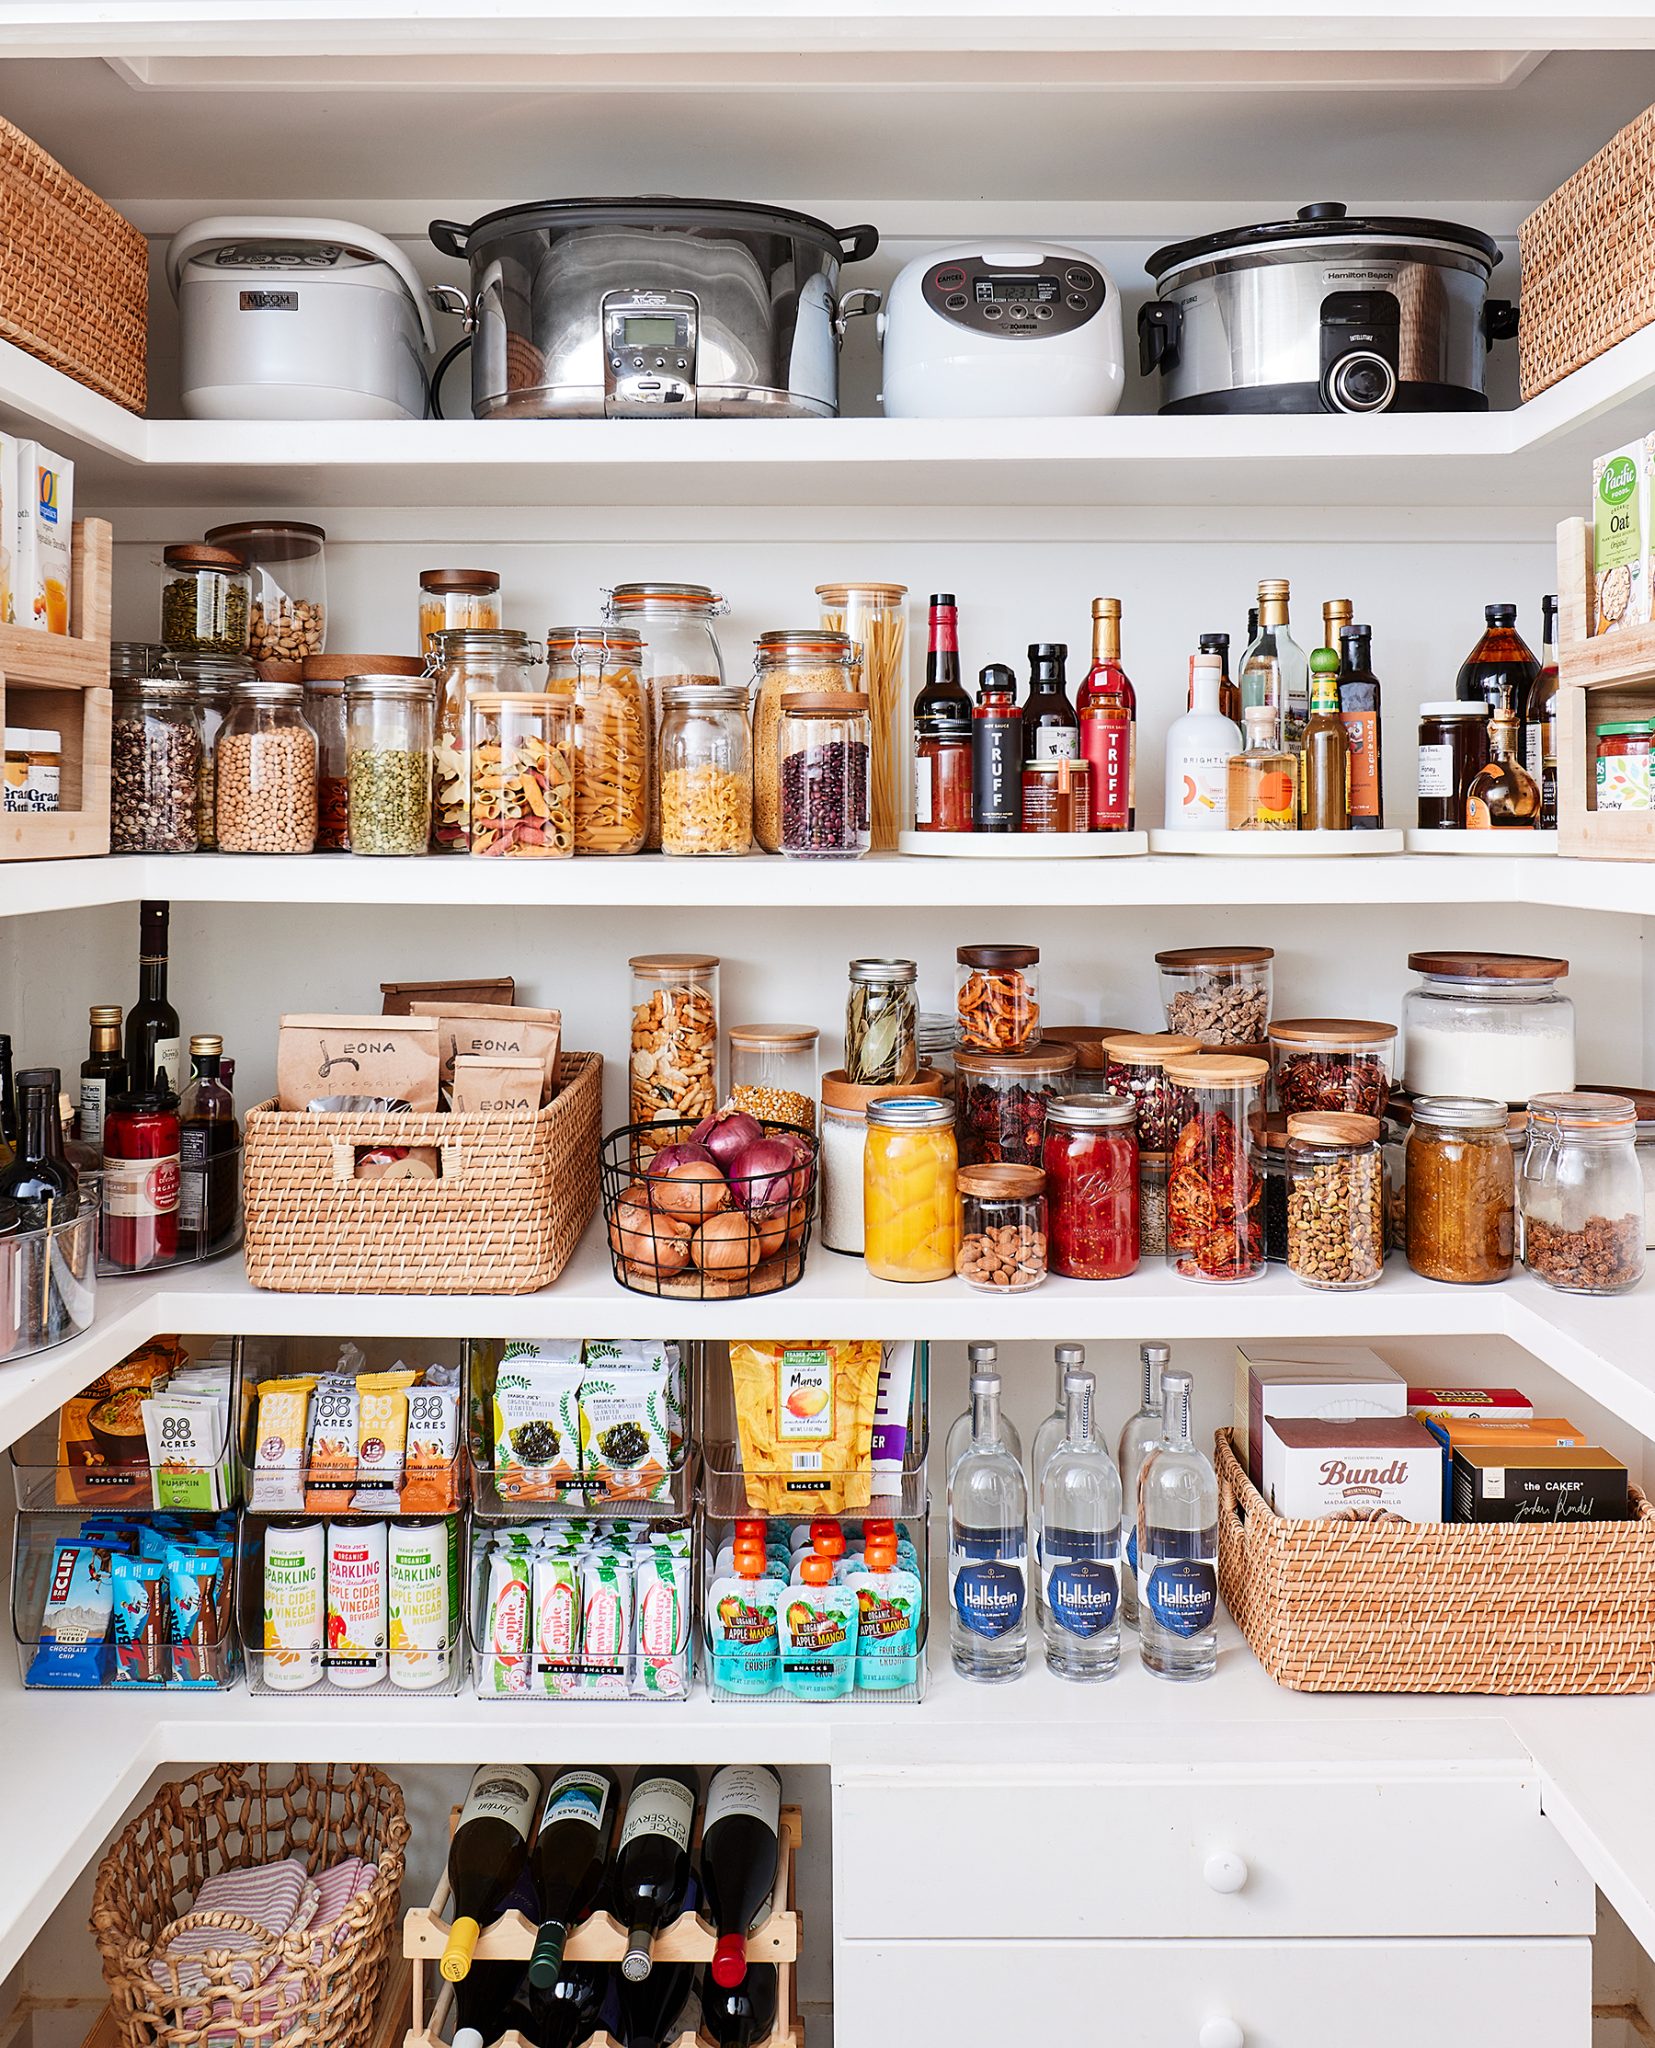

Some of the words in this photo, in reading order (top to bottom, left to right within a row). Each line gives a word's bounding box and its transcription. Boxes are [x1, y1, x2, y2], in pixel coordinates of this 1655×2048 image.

[1328, 269, 1367, 279] Hamilton
[1367, 271, 1394, 279] Beach
[247, 294, 291, 305] MICOM
[1604, 463, 1634, 494] Pacific
[18, 509, 30, 518] oth
[1610, 512, 1630, 533] Oat
[991, 732, 1003, 807] TRUFF
[1108, 733, 1119, 807] TRUFF
[790, 1372, 823, 1388] Mango
[320, 1395, 351, 1418] 88
[362, 1394, 392, 1420] 88
[412, 1395, 443, 1420] 88
[162, 1417, 192, 1440] 88
[315, 1419, 353, 1428] ACRES
[409, 1421, 446, 1430] ACRES
[160, 1440, 197, 1449] ACRES
[310, 1461, 350, 1469] CINNAMON
[1318, 1460, 1409, 1486] Bundt
[161, 1480, 199, 1488] PUMPKIN
[1524, 1482, 1540, 1491] the
[1545, 1482, 1581, 1491] CAKER
[55, 1551, 75, 1590] CLIF
[289, 1589, 316, 1605] CIDER
[353, 1583, 380, 1599] CIDER
[416, 1586, 442, 1603] CIDER
[964, 1581, 1018, 1607] Hallstein
[1057, 1580, 1111, 1606] Hallstein
[1158, 1581, 1211, 1606] Hallstein
[275, 1603, 316, 1619] VINEGAR
[340, 1597, 380, 1612] VINEGAR
[402, 1600, 442, 1616] VINEGAR
[285, 1616, 316, 1628] BEVERAGE
[349, 1609, 380, 1621] BEVERAGE
[413, 1613, 442, 1625] BEVERAGE
[497, 1613, 506, 1630] this
[504, 1603, 519, 1641] apple
[735, 1617, 758, 1625] ORGANIC
[867, 1610, 891, 1620] ORGANIC
[551, 1607, 565, 1645] apple
[728, 1628, 748, 1640] APPLE
[749, 1625, 776, 1640] MANGO
[860, 1624, 880, 1636] APPLE
[882, 1618, 909, 1633] MANGO
[796, 1635, 817, 1647] APPLE
[817, 1631, 846, 1645] MANGO
[49, 1645, 88, 1653] CHOCOLATE
[879, 1645, 895, 1654] FRUIT
[557, 1808, 579, 1817] PASS
[579, 1809, 598, 1822] THE
[649, 1822, 685, 1845] RIDGE
